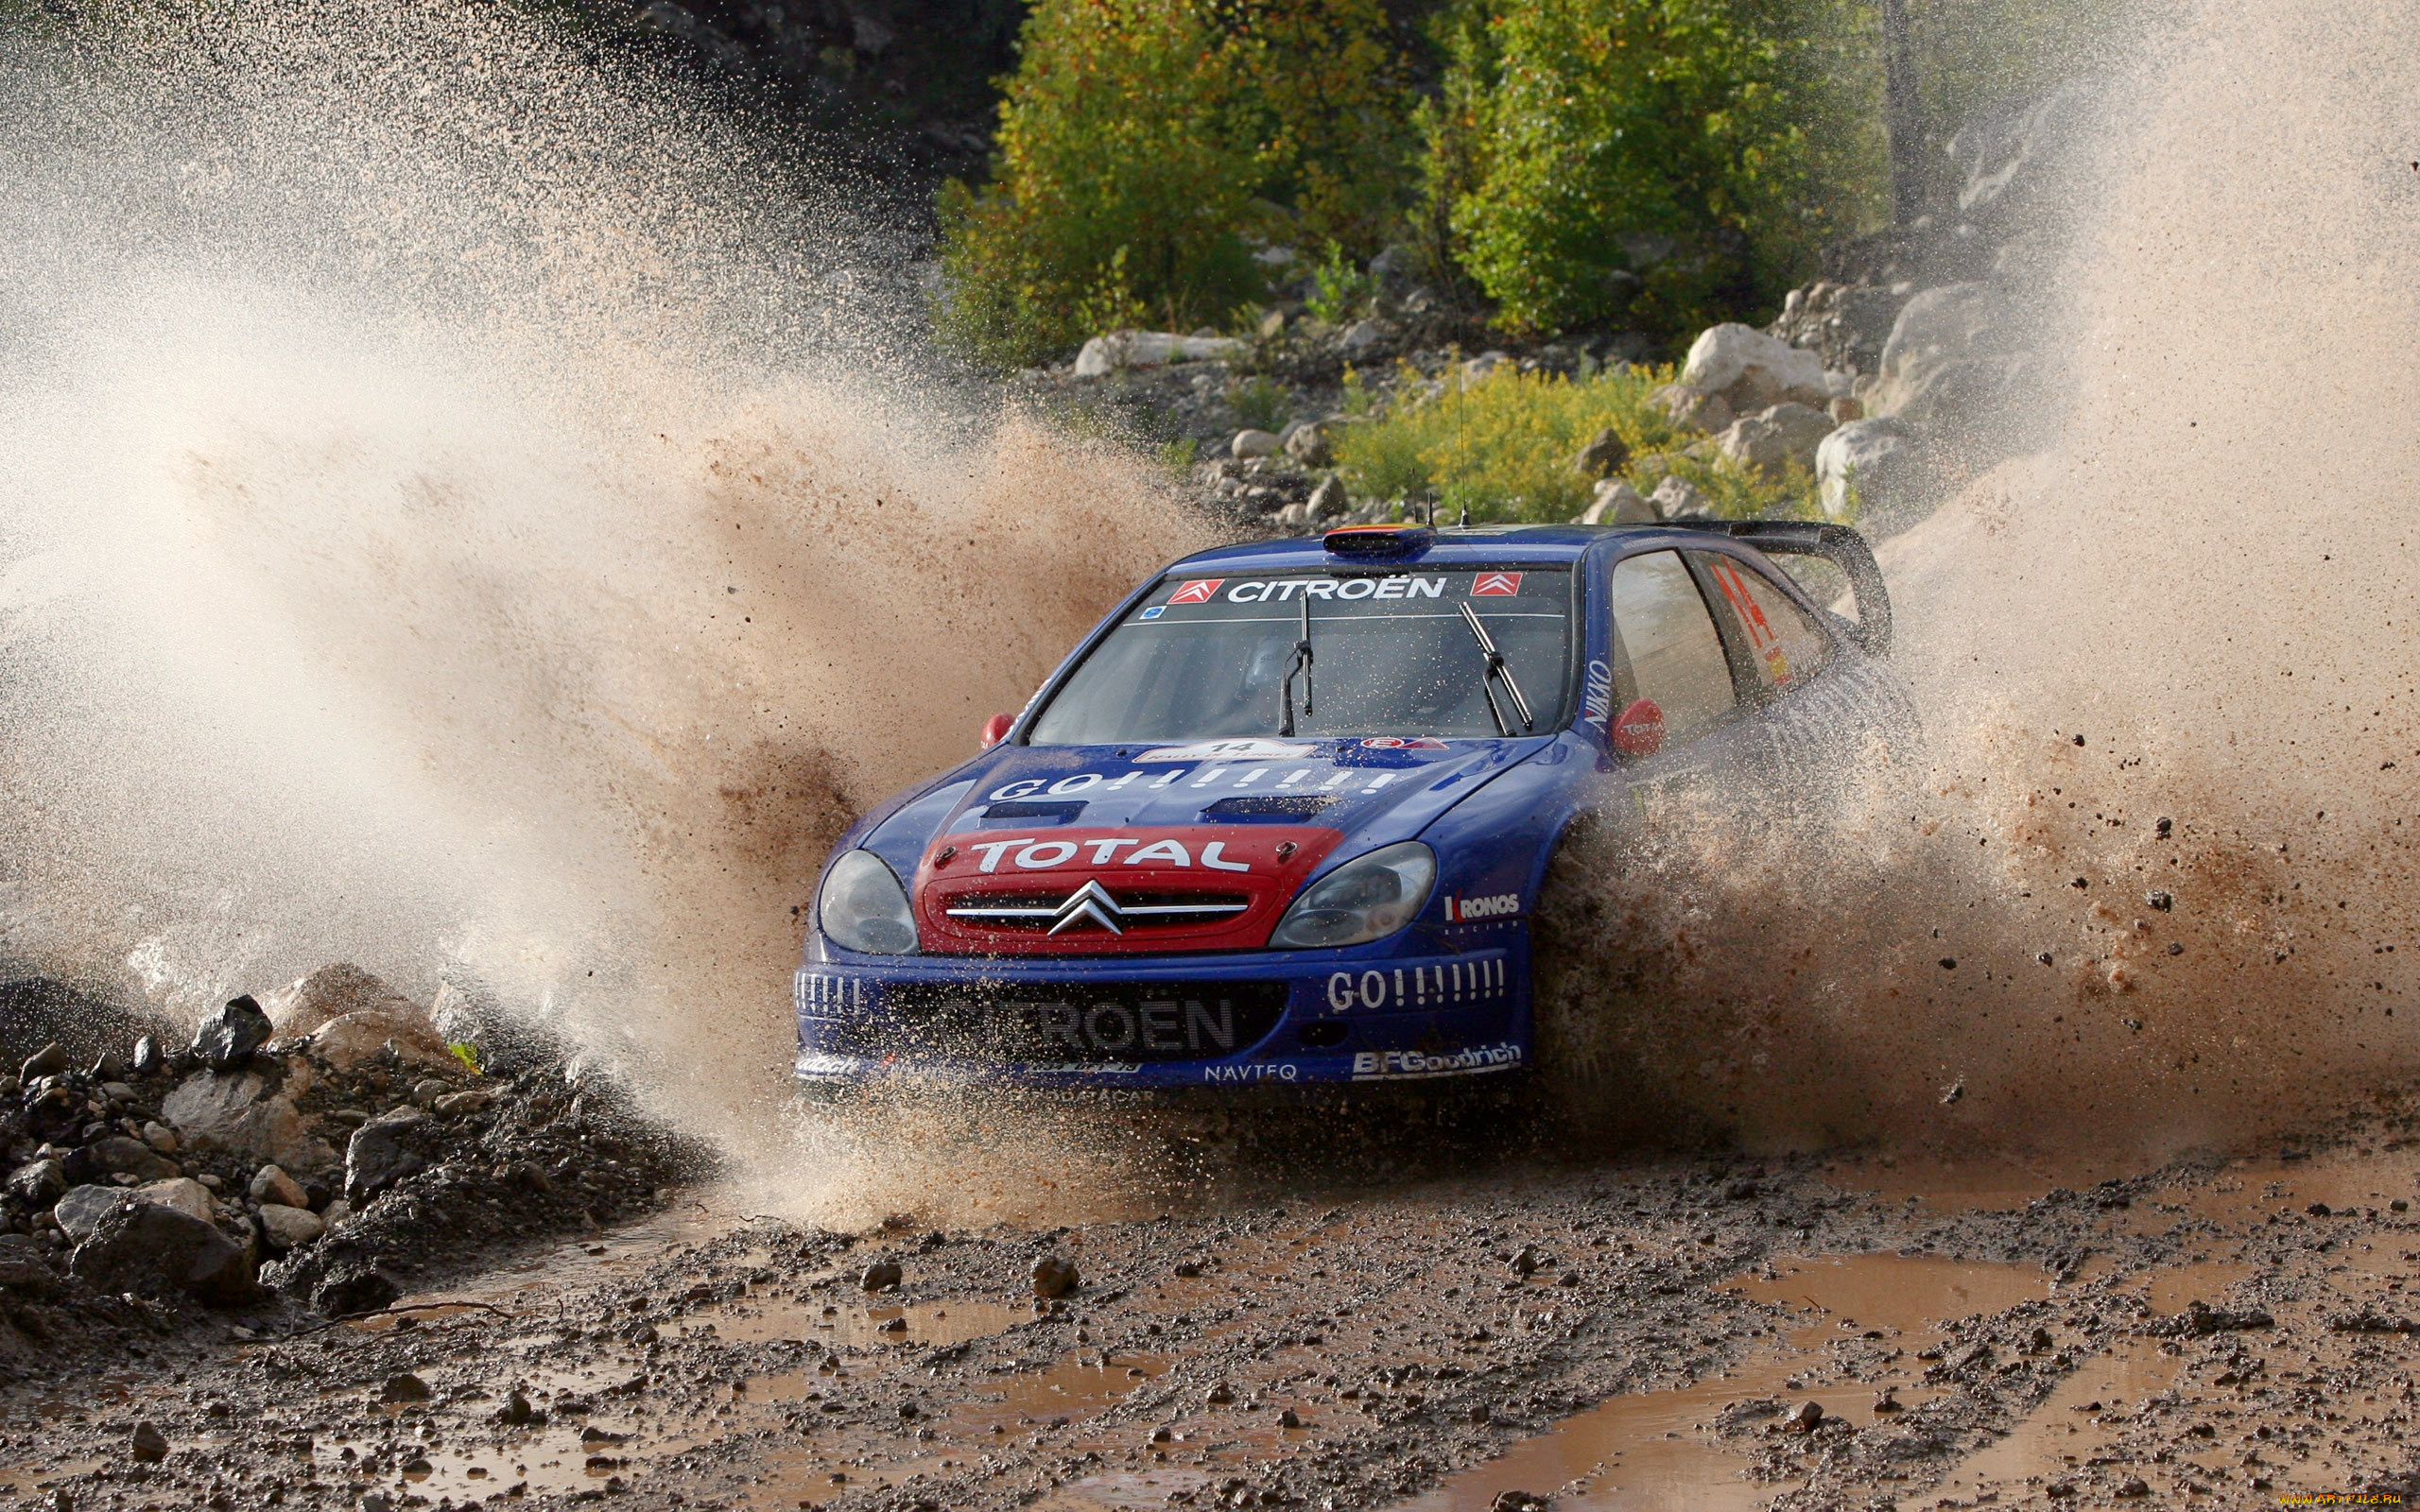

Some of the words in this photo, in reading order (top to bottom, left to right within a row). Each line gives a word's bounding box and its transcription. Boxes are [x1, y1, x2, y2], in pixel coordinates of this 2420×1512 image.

[1228, 574, 1447, 603] CITROËN
[1584, 660, 1612, 734] NIKKO
[1623, 722, 1665, 735] TOTA
[1211, 742, 1255, 752] 14
[971, 837, 1251, 873] TOTAL
[1444, 888, 1520, 922] KRONOS
[1444, 919, 1518, 936] RACING
[1327, 958, 1504, 1011] GO!!!!!!!
[1353, 1041, 1522, 1074] BFGoodrich
[1204, 1064, 1297, 1083] NAVTEQ
